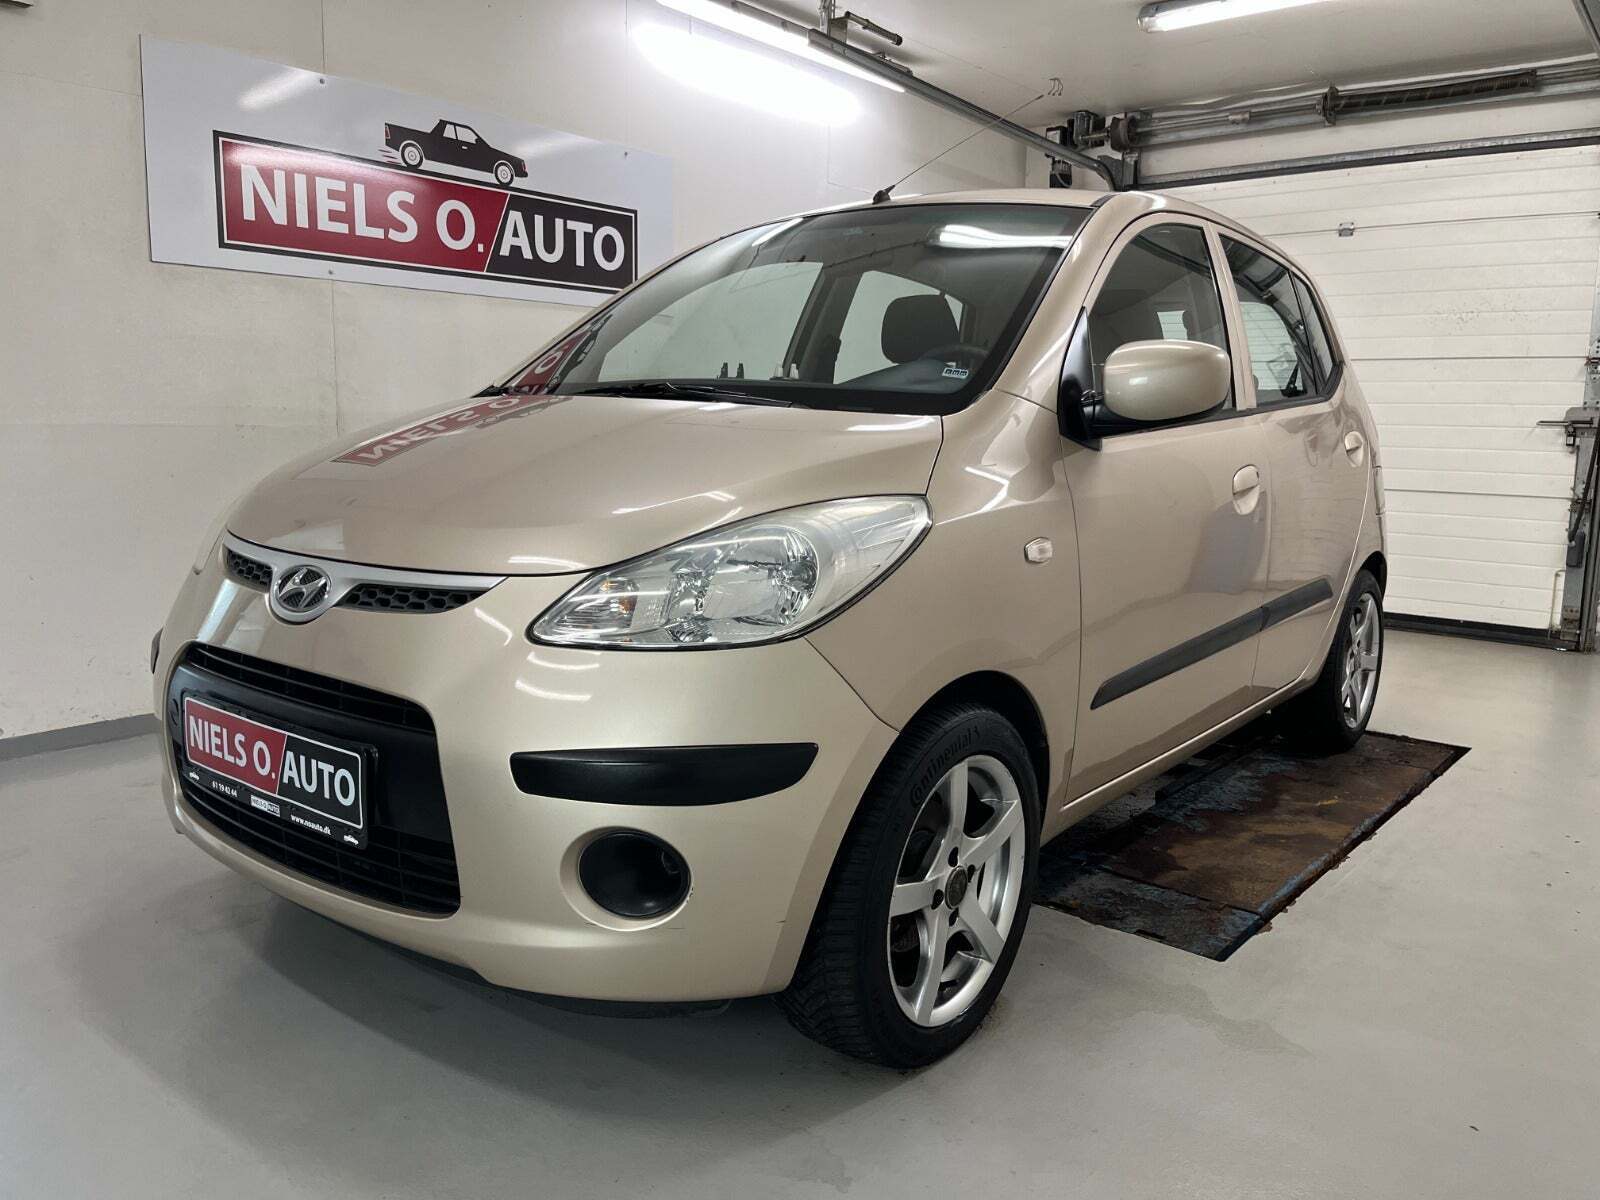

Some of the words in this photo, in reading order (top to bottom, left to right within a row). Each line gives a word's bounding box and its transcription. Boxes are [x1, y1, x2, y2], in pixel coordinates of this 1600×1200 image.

[240, 163, 418, 244] NIELS
[436, 199, 485, 254] O.
[499, 208, 625, 271] AUTO
[189, 715, 247, 768] NIELS
[253, 740, 276, 779] O.
[282, 750, 356, 806] AUTO
[910, 728, 973, 808] Continental
